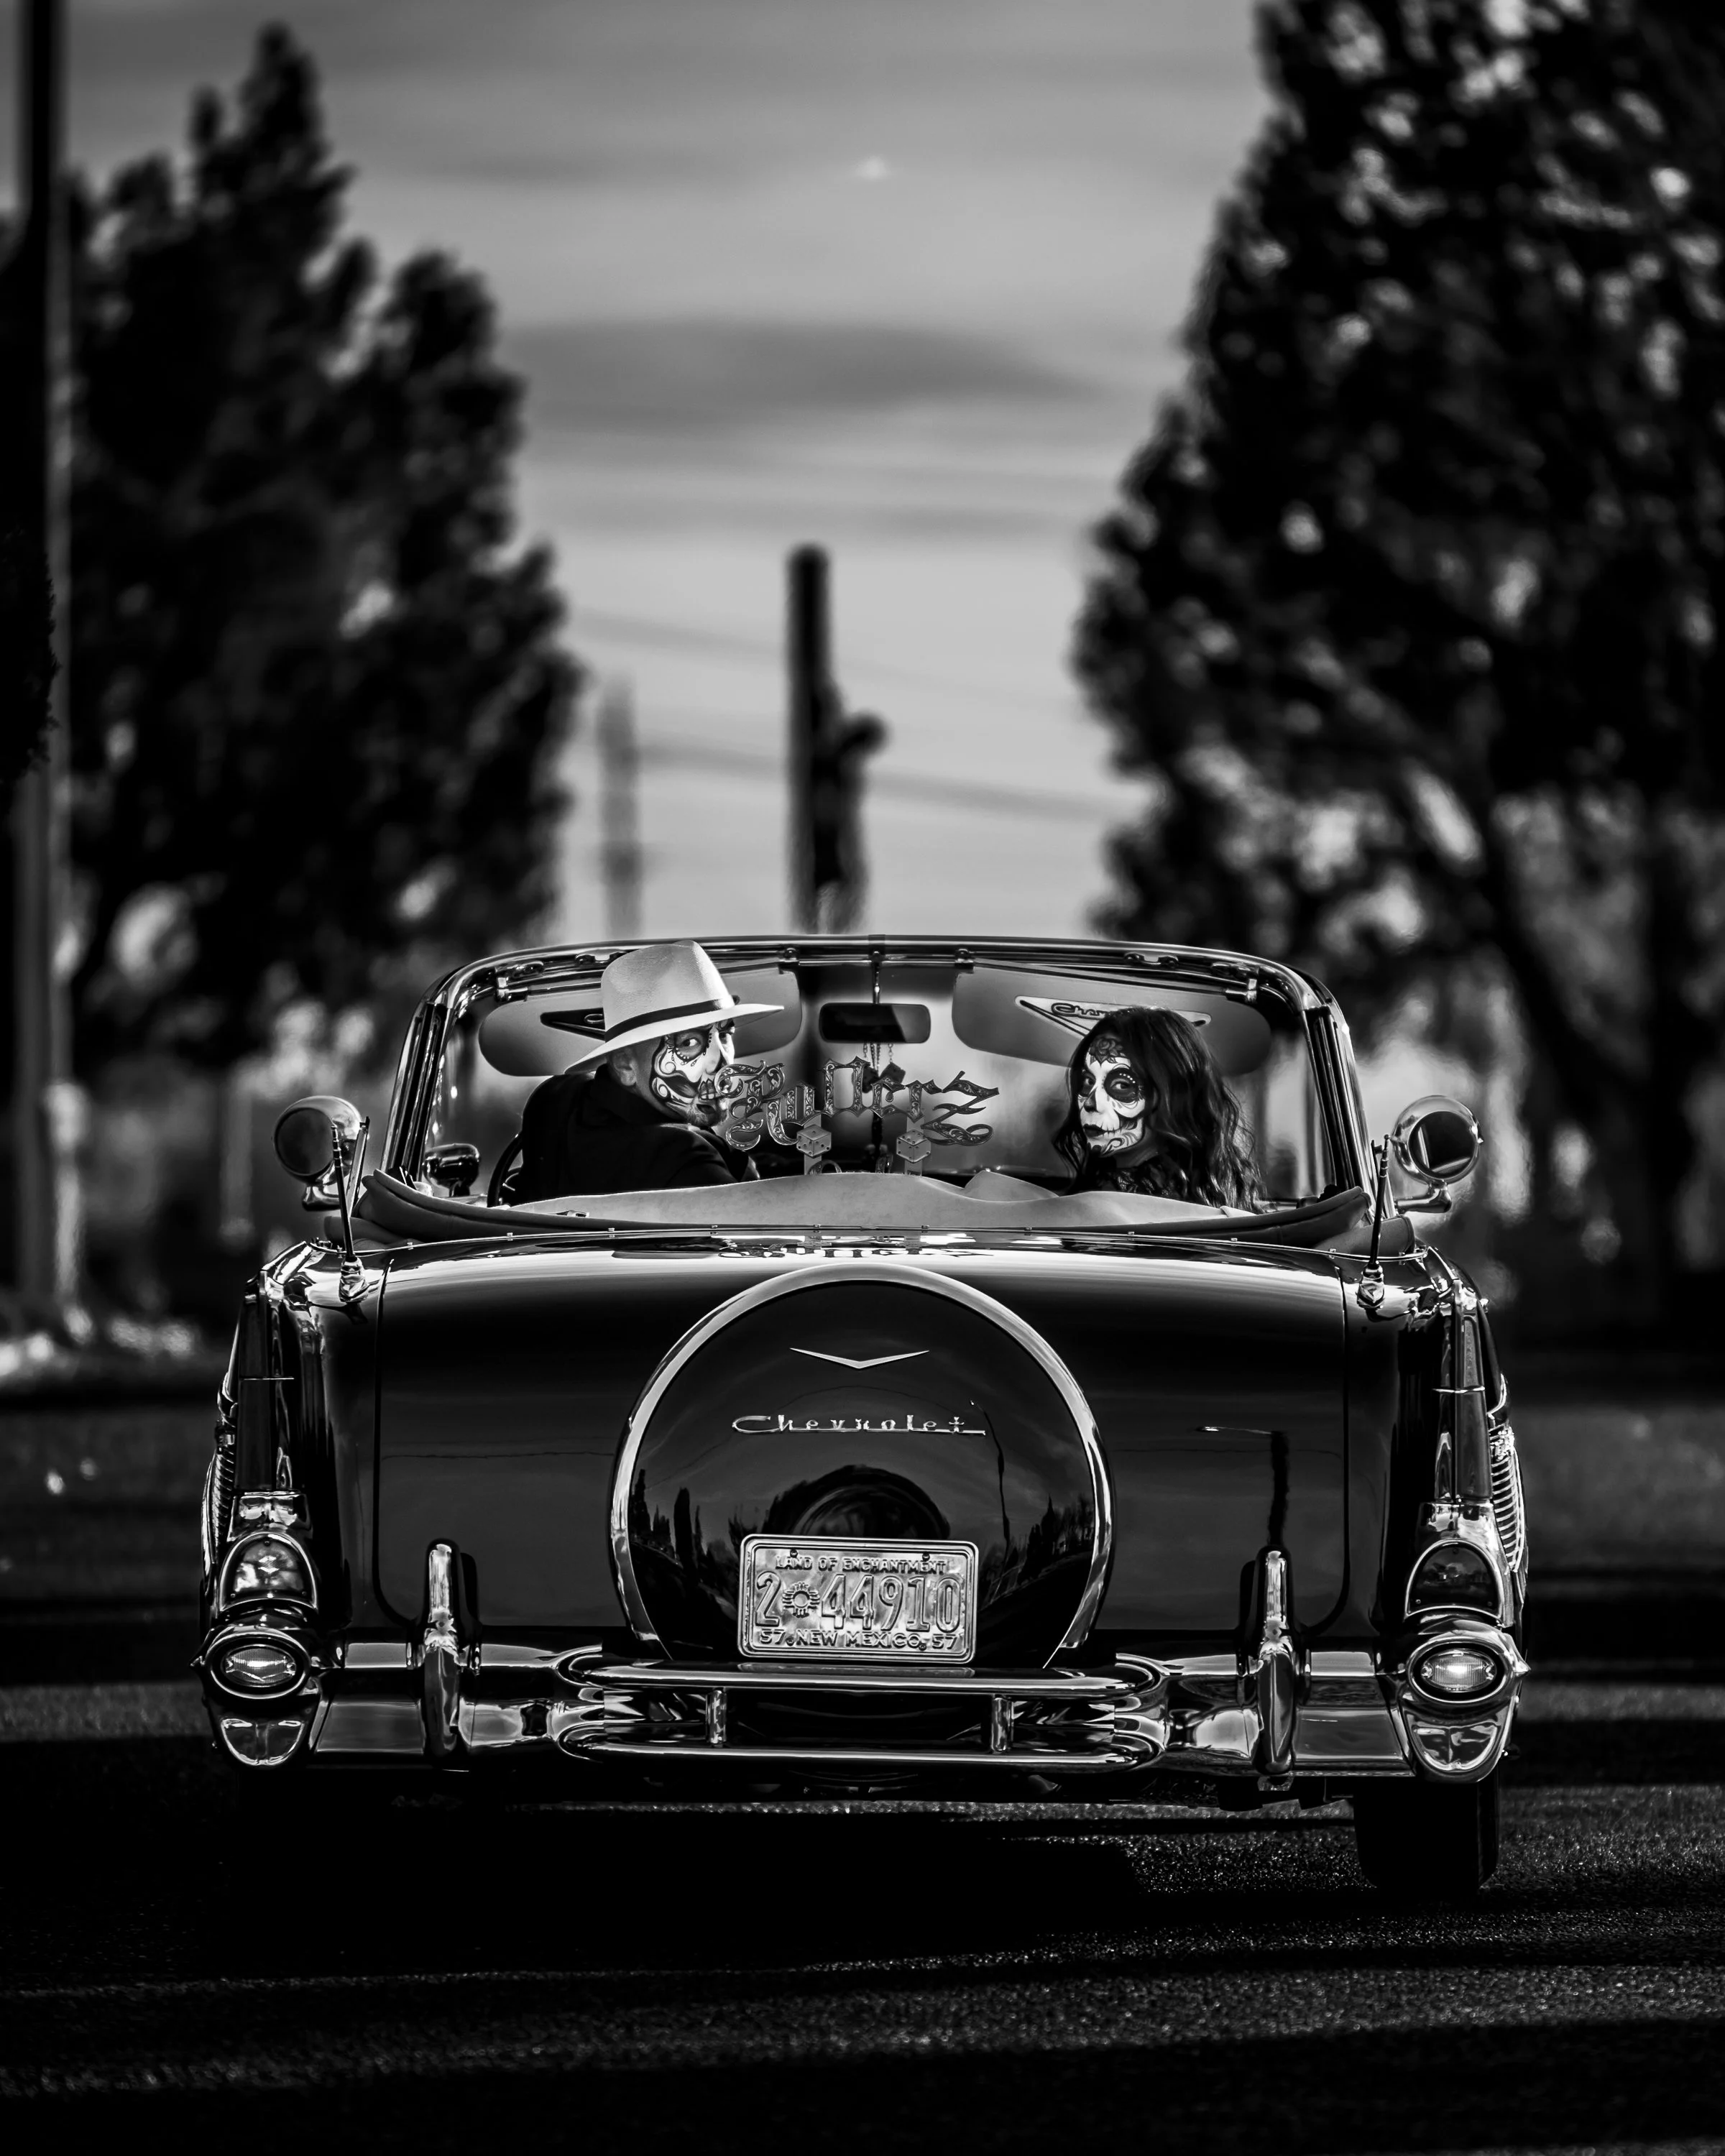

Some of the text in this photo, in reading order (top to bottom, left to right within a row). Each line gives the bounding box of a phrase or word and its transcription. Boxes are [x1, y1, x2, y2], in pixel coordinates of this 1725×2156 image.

[732, 1414, 986, 1435] Chevrolet
[776, 1555, 947, 1575] LAND OF ENCHANTMENT
[755, 1571, 962, 1633] 2 44910
[760, 1628, 958, 1650] 57 NEW MEXICO 57
